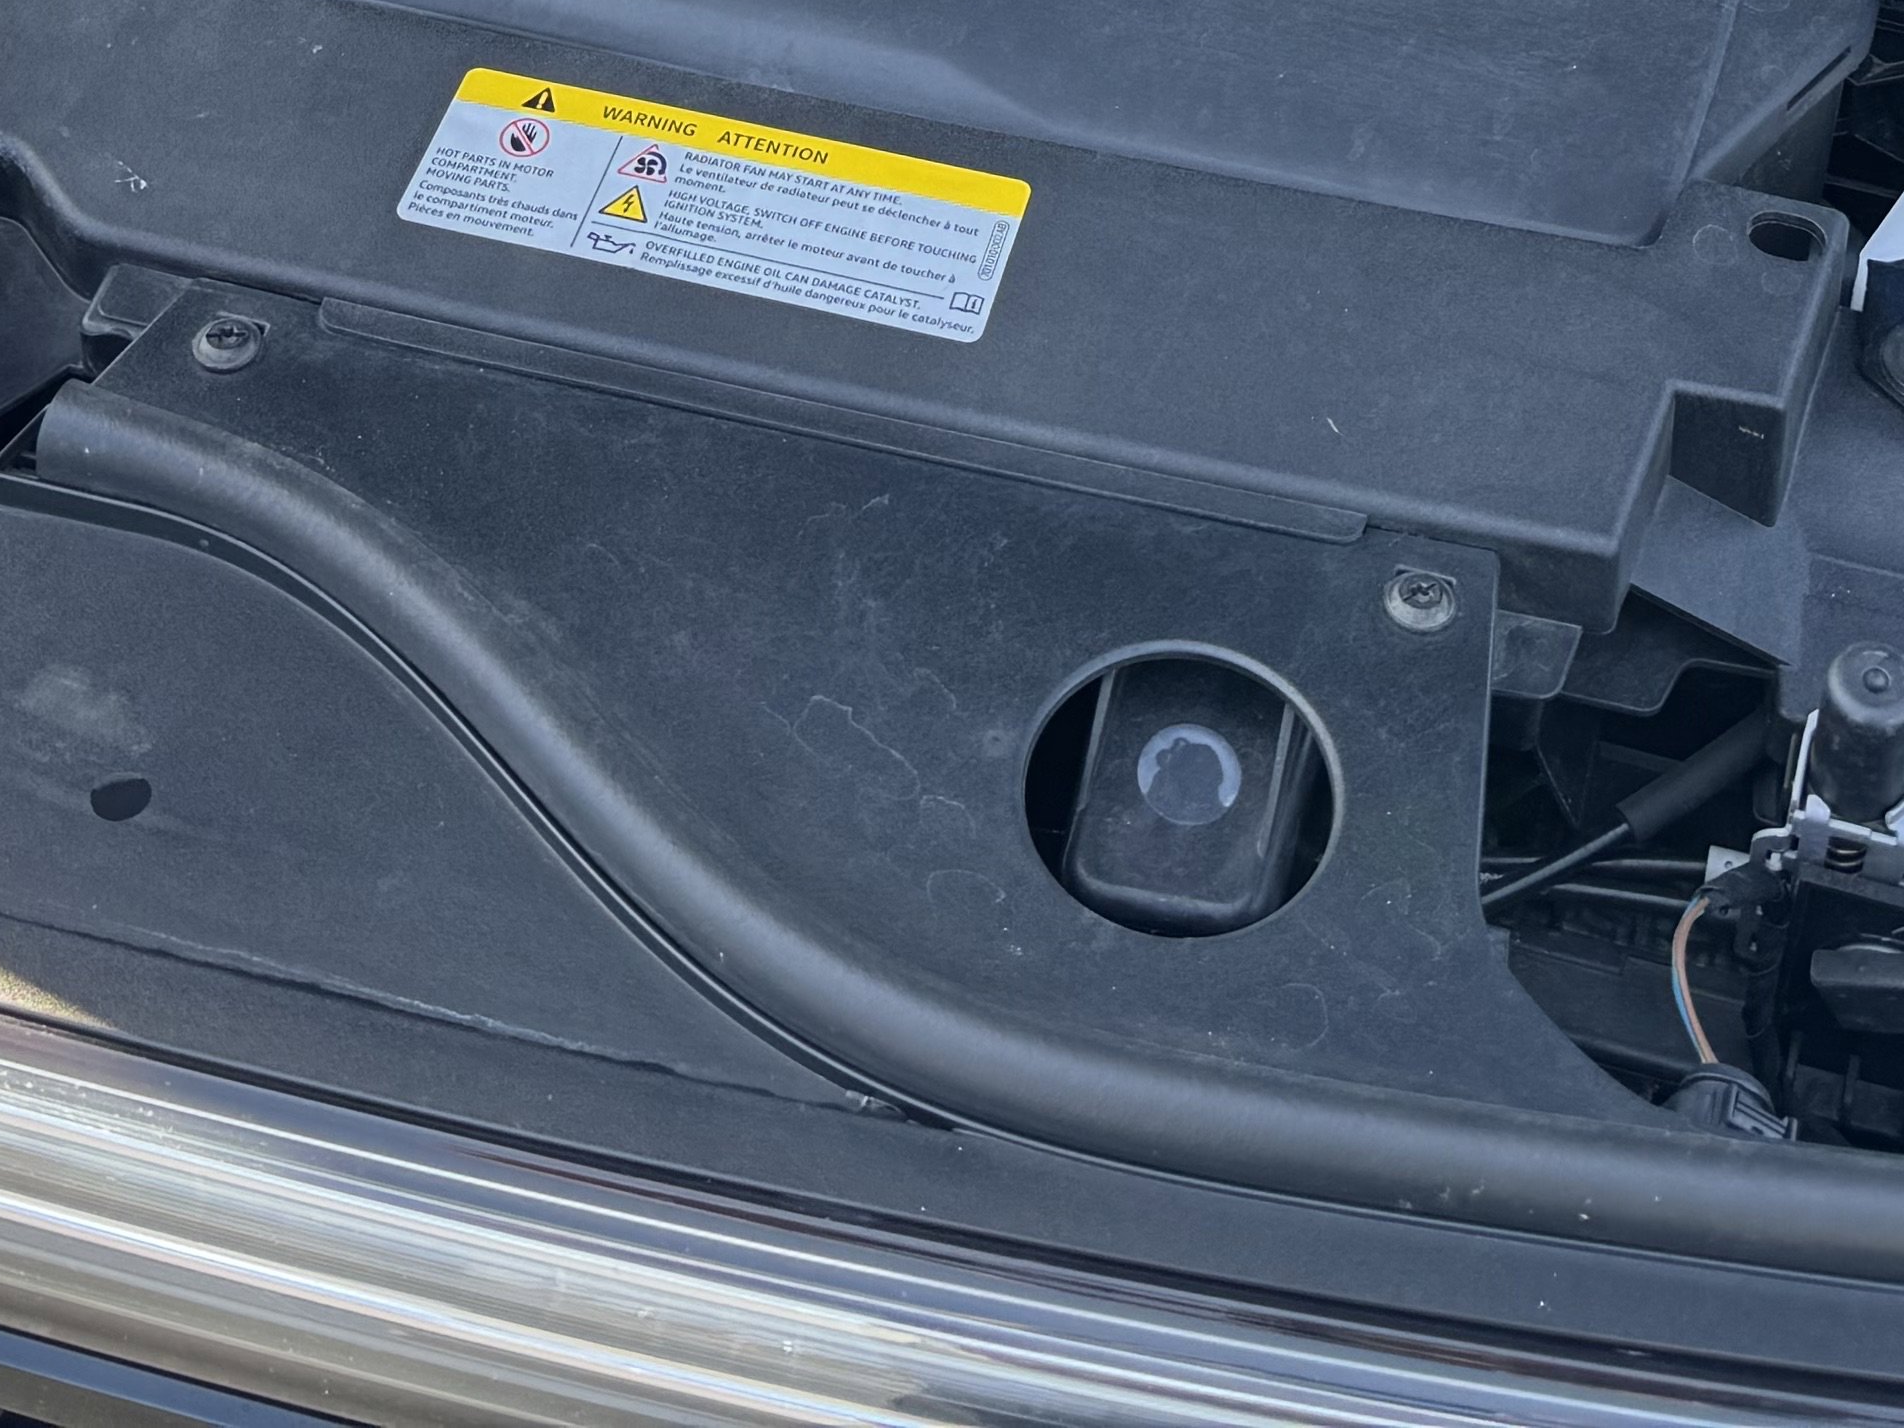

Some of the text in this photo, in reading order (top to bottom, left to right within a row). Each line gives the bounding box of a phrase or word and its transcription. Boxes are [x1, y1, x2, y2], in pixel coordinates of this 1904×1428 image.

[603, 105, 698, 137] WARNING
[436, 147, 555, 178] HOT PARTS IN MOTOR
[716, 130, 829, 165] ATTENTION
[425, 167, 510, 192] MOVING PARTS.
[674, 176, 726, 193] moment.
[684, 151, 902, 206] RADIATOR FAN MAY START AT ANY TIME.
[413, 190, 554, 229] le compartiment moteur.
[418, 179, 578, 221] Composants très chauds dans
[663, 199, 764, 229] IGNITION SYSTEM.
[676, 164, 979, 237] Le ventilateur de radiateur peut se déclencher à tout
[407, 201, 534, 237] Pièces en mouvement.
[653, 220, 717, 242] l'allumage.
[668, 189, 698, 206] HIGH
[753, 207, 798, 225] SWITCH
[799, 217, 823, 230] OFF
[823, 223, 868, 240] ENGINE
[869, 232, 916, 251] BEFORE
[918, 242, 977, 264] TOUCHING
[655, 211, 956, 284] Haute tension, arrêter le moteur avant de toucher à
[639, 251, 974, 334] Remplissage excessif d'huile dangereux pour le catalyseur.
[645, 240, 921, 310] OVERFILLED ENGINE OIL CAN DAMAGE CATALYST.
